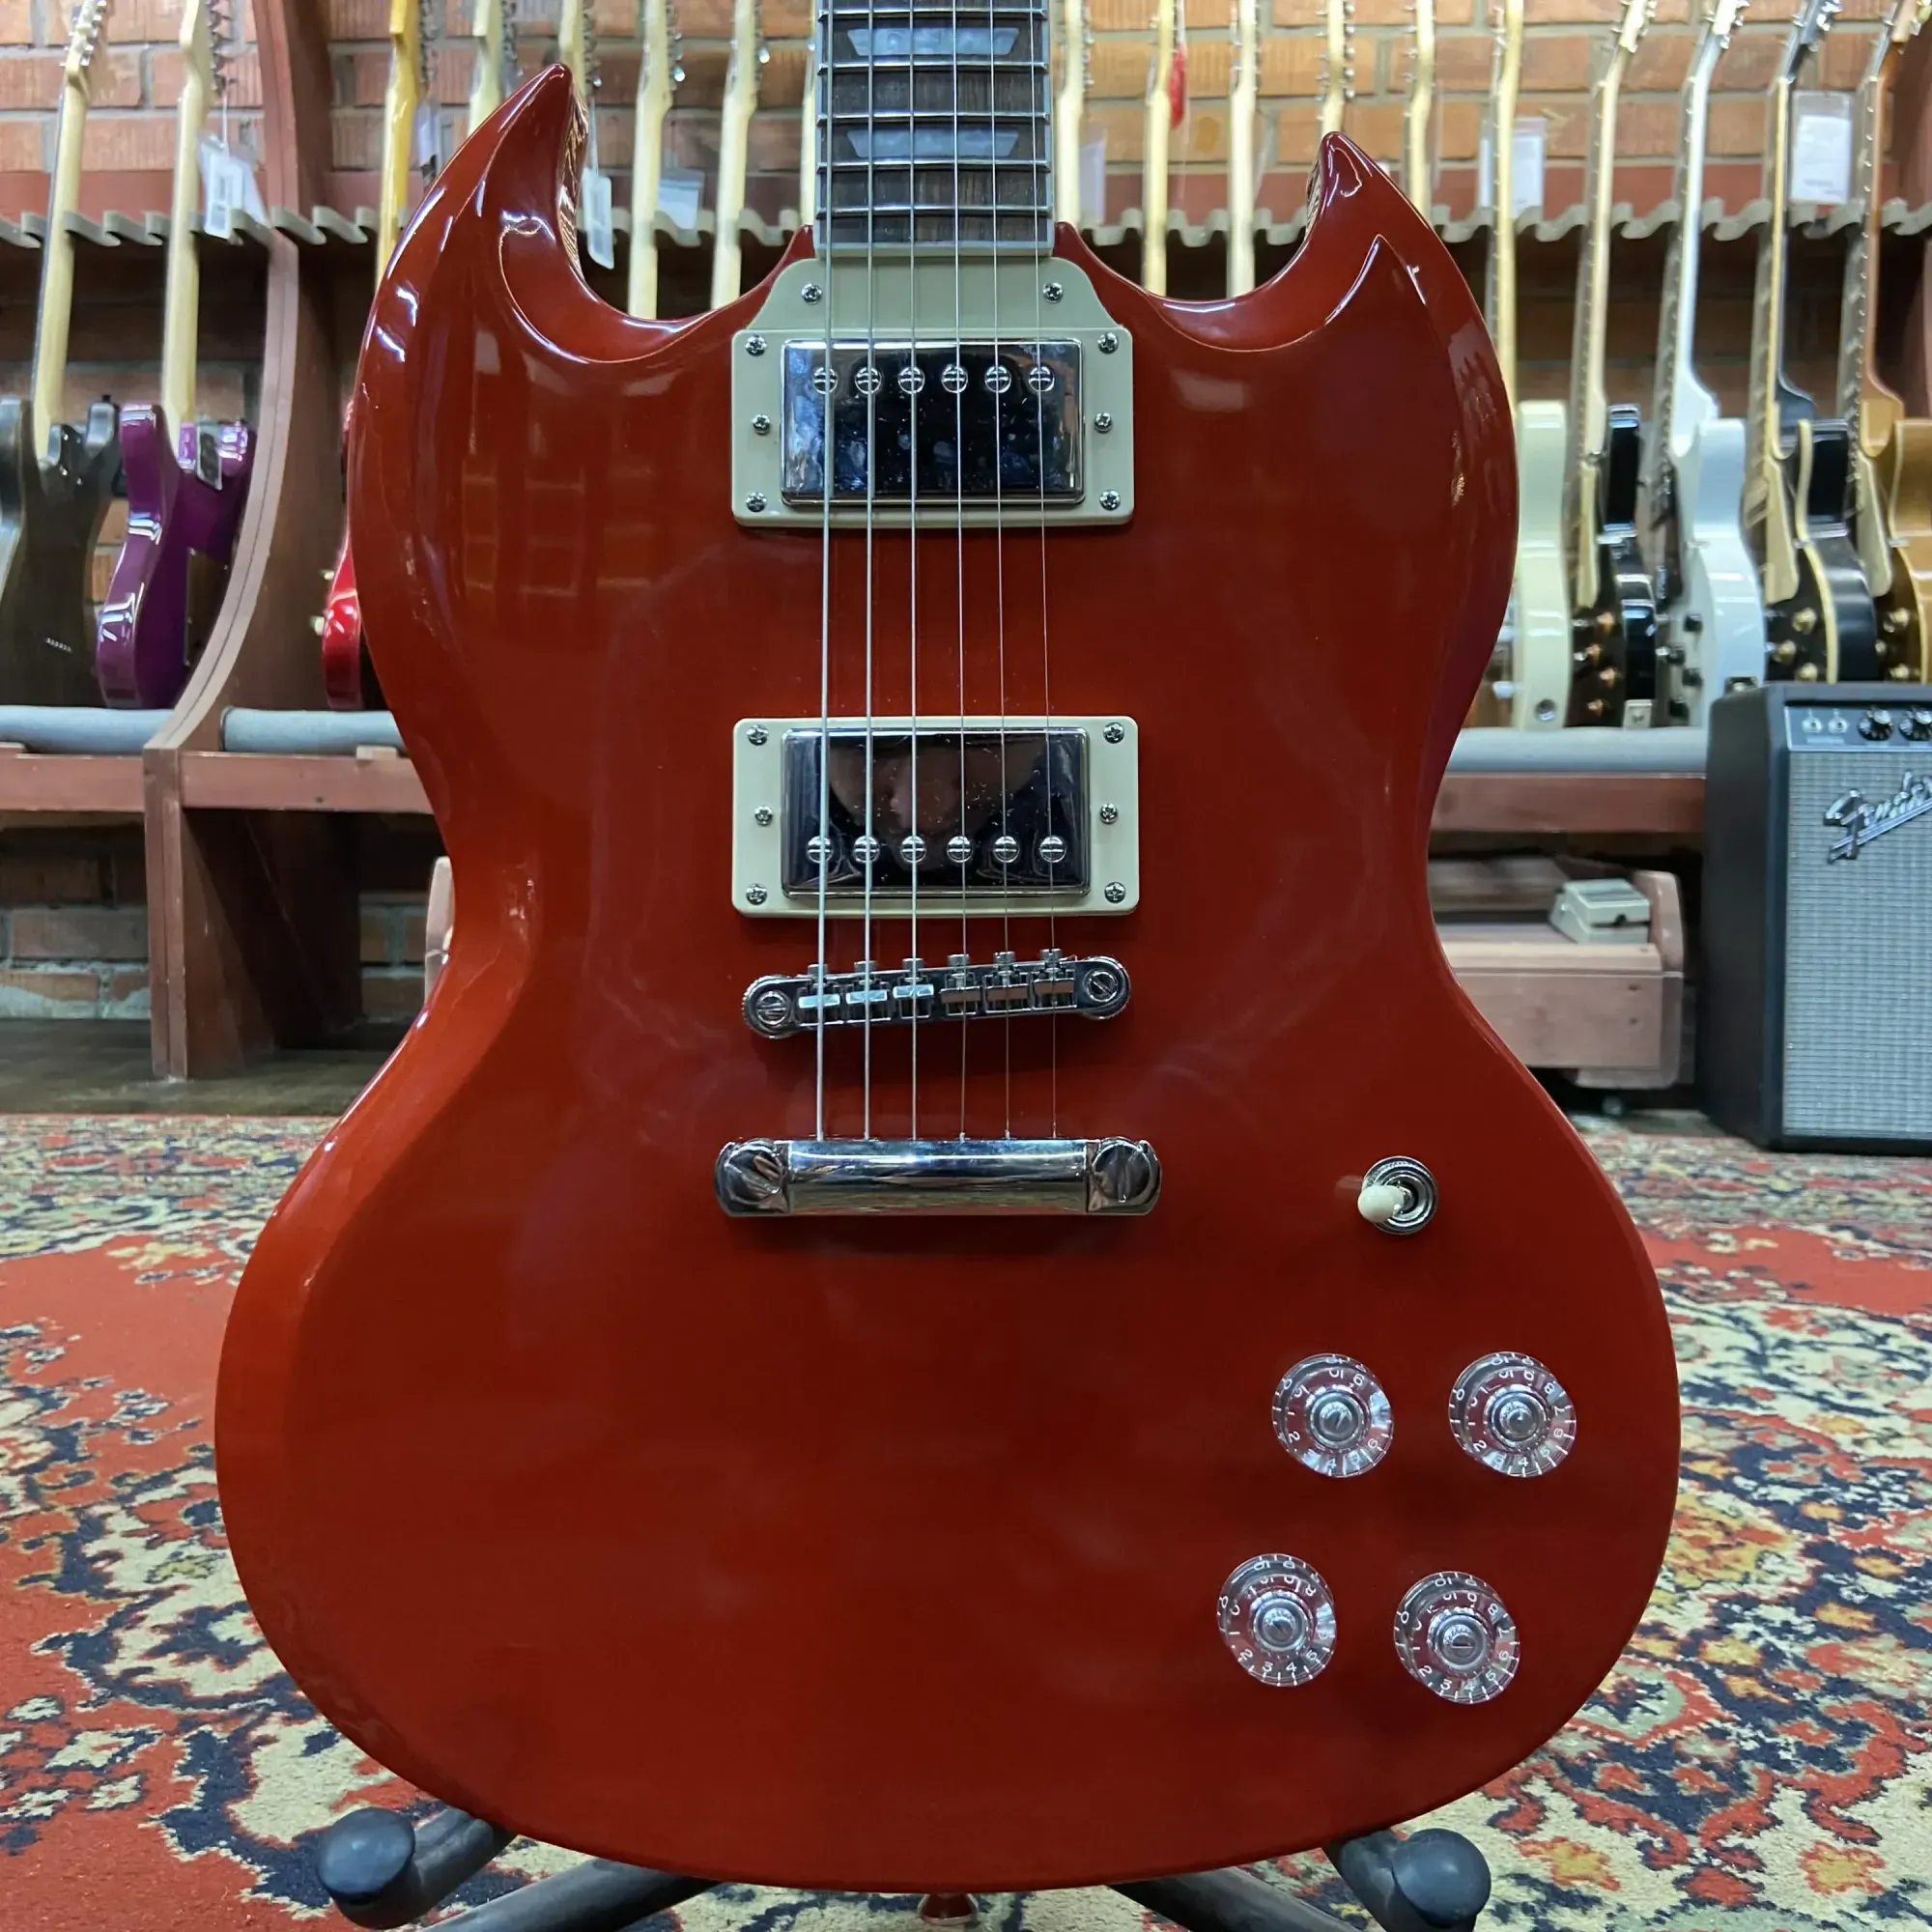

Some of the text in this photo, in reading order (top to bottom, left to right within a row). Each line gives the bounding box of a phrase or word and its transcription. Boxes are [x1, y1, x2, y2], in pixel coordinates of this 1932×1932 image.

[1545, 1381, 1555, 1394] 8
[1553, 1428, 1564, 1438] 6
[1288, 1431, 1300, 1443] 2
[1368, 1438, 1378, 1449] 6
[1473, 1439, 1487, 1452] 2
[1518, 1457, 1529, 1467] 4
[1488, 1603, 1498, 1616] 8
[1400, 1610, 1409, 1624] 0
[1239, 1648, 1254, 1661] 2
[1262, 1661, 1274, 1672] 3
[1286, 1662, 1297, 1672] 4
[1305, 1649, 1318, 1661] 5
[1498, 1650, 1509, 1661] 6
[1418, 1665, 1433, 1677] 2
[1486, 1669, 1496, 1681] 5
[1440, 1678, 1453, 1690] 3
